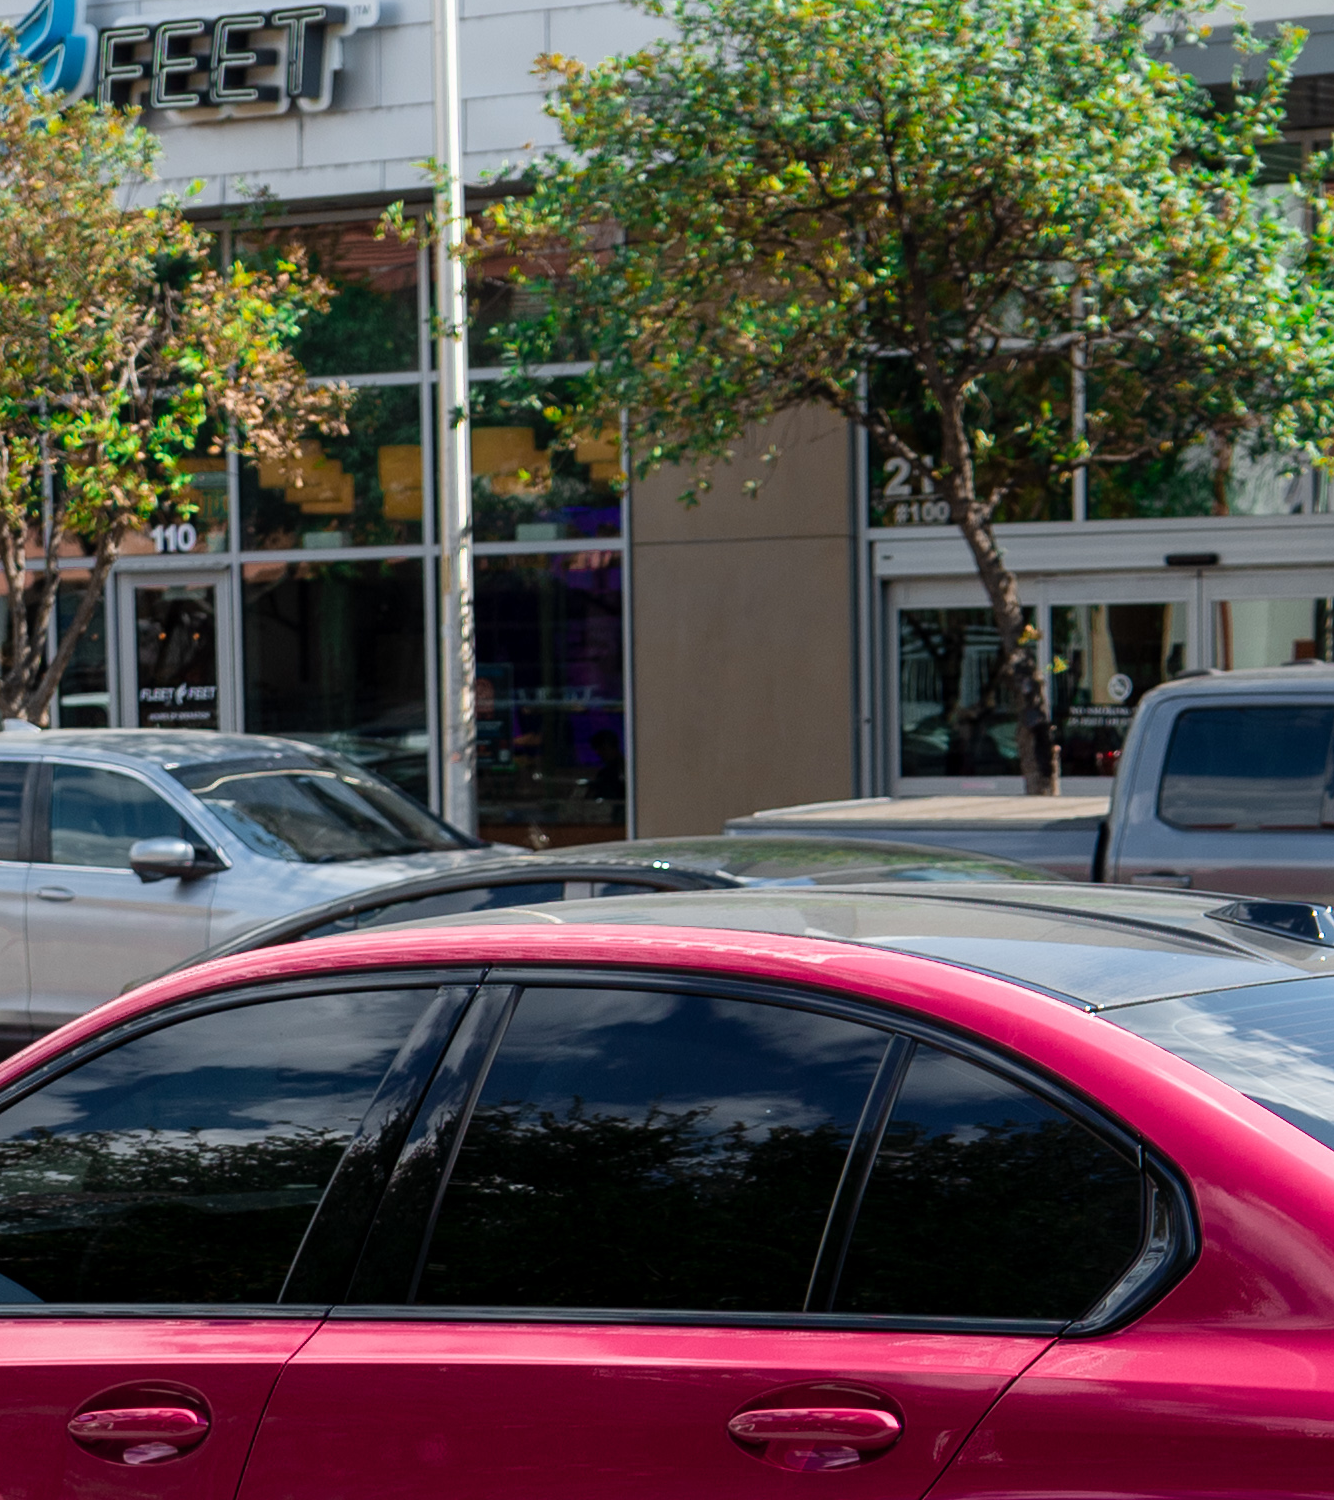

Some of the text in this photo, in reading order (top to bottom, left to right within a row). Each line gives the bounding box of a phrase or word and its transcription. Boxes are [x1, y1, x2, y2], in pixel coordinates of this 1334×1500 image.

[97, 5, 331, 112] FEET
[893, 501, 951, 524] #100
[149, 522, 197, 553] 110
[140, 685, 218, 702] FLEET FEET
